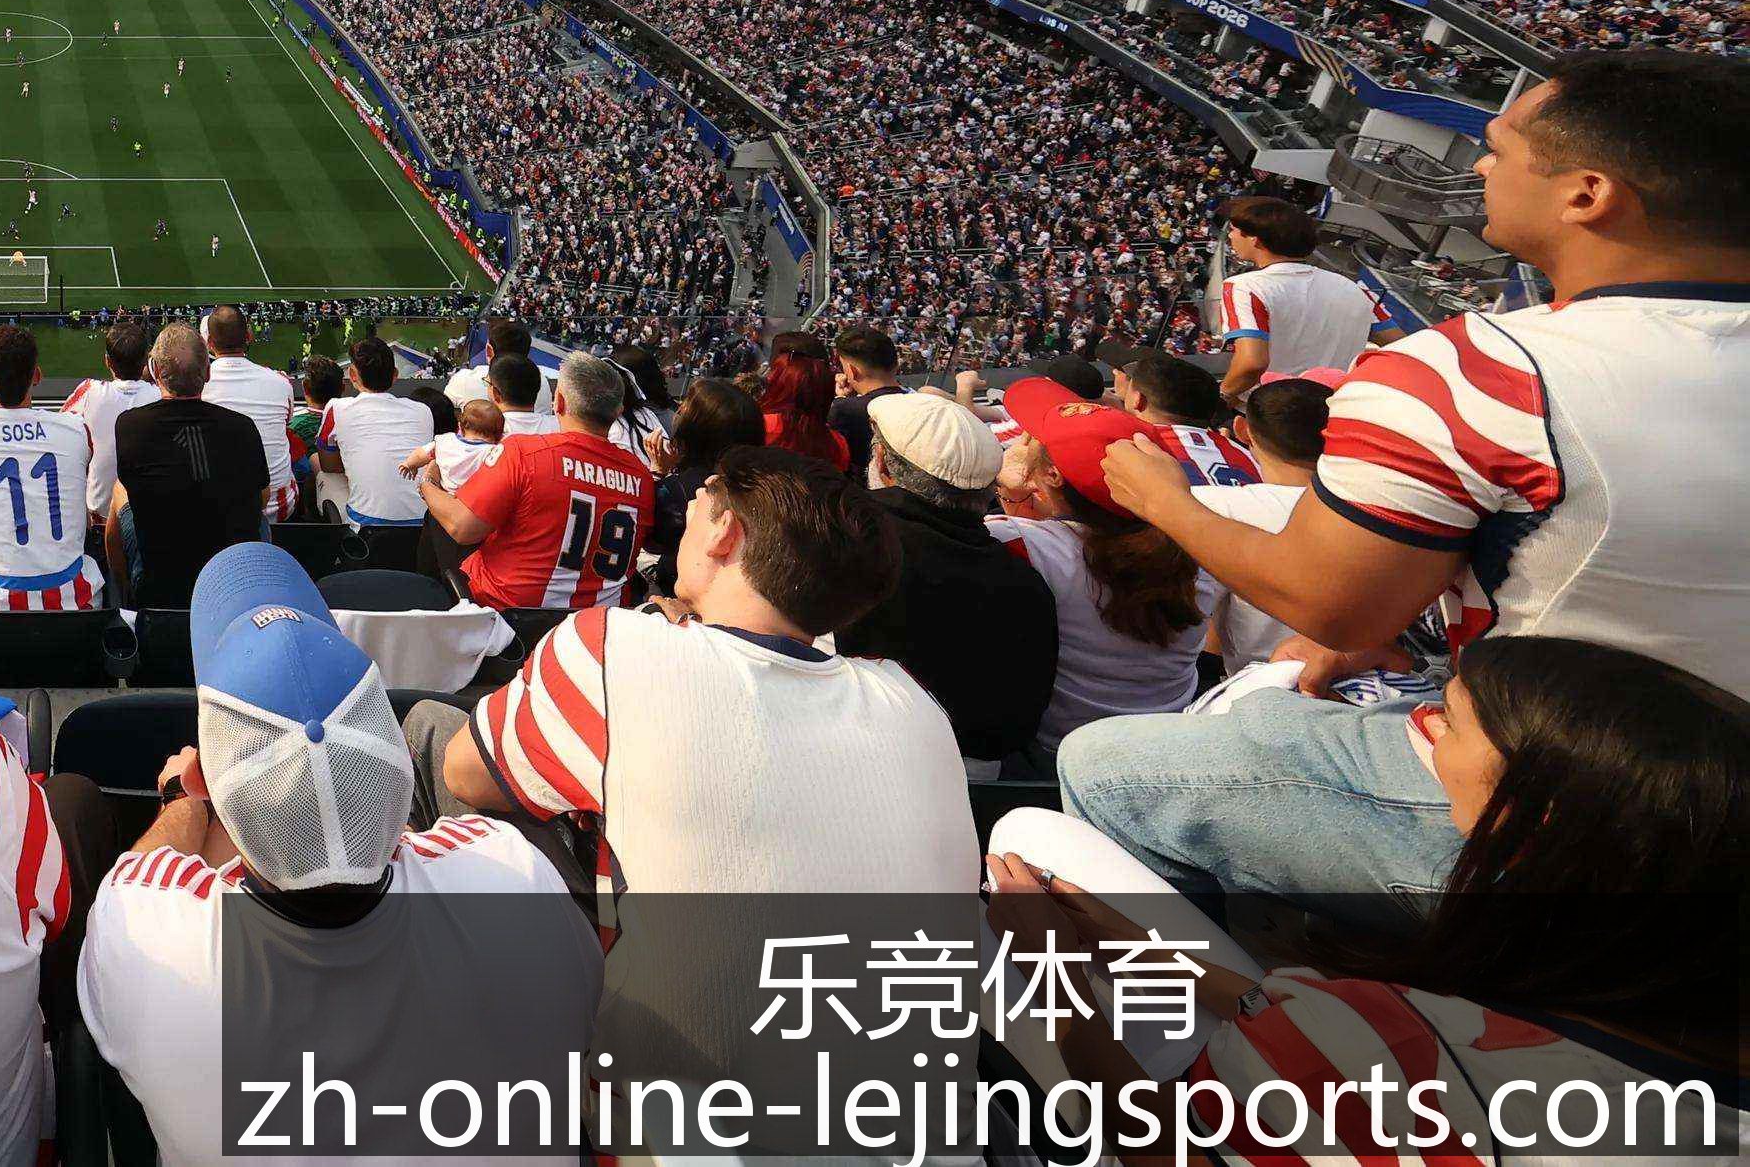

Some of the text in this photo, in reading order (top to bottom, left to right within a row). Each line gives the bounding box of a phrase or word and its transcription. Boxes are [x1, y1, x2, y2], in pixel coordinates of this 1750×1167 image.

[1206, 0, 1249, 29] 2026
[2, 422, 47, 443] SOSA
[562, 456, 642, 498] PARAGUAY
[557, 494, 637, 581] 19
